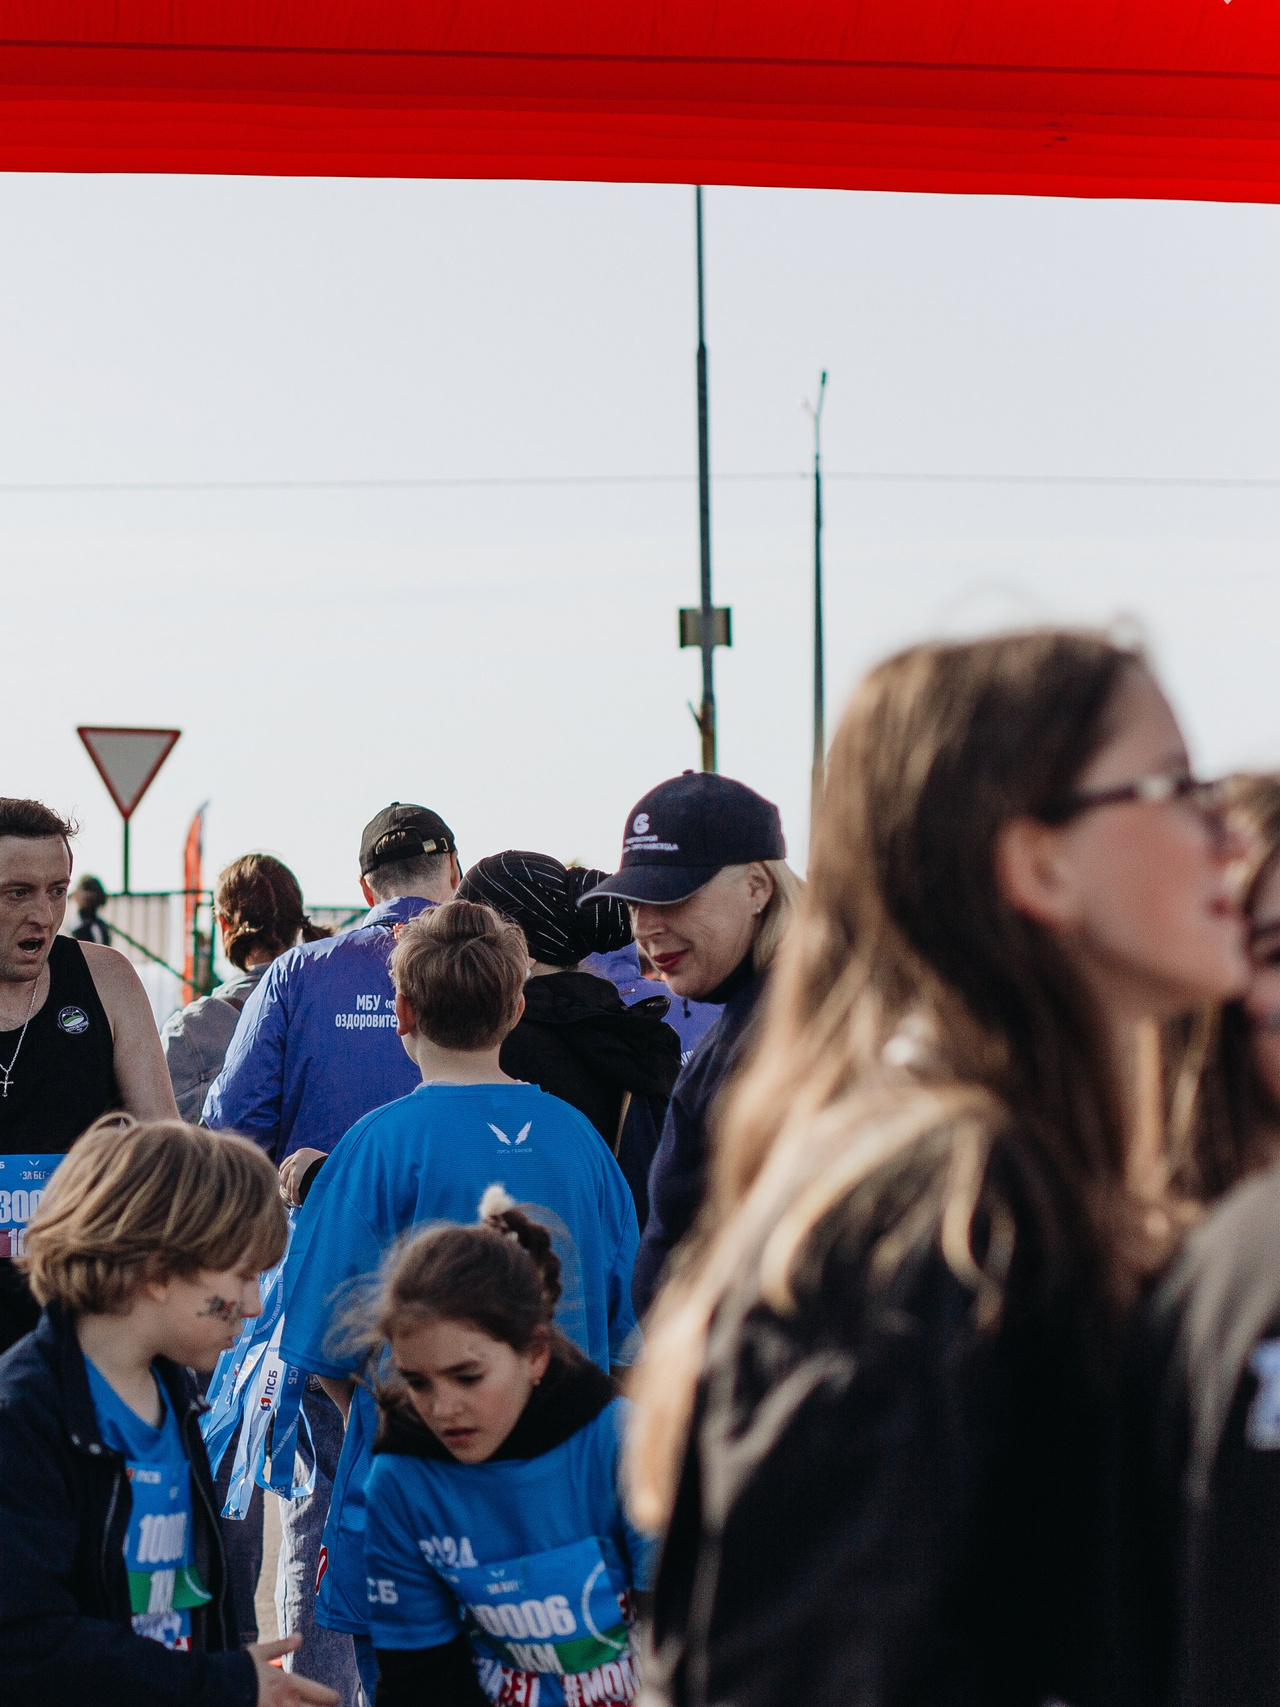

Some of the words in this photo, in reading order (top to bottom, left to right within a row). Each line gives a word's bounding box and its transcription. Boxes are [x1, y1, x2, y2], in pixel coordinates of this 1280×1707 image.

[356, 994, 381, 1011] МБУ
[335, 1013, 400, 1031] оздоровите
[264, 1369, 278, 1396] ПСБ
